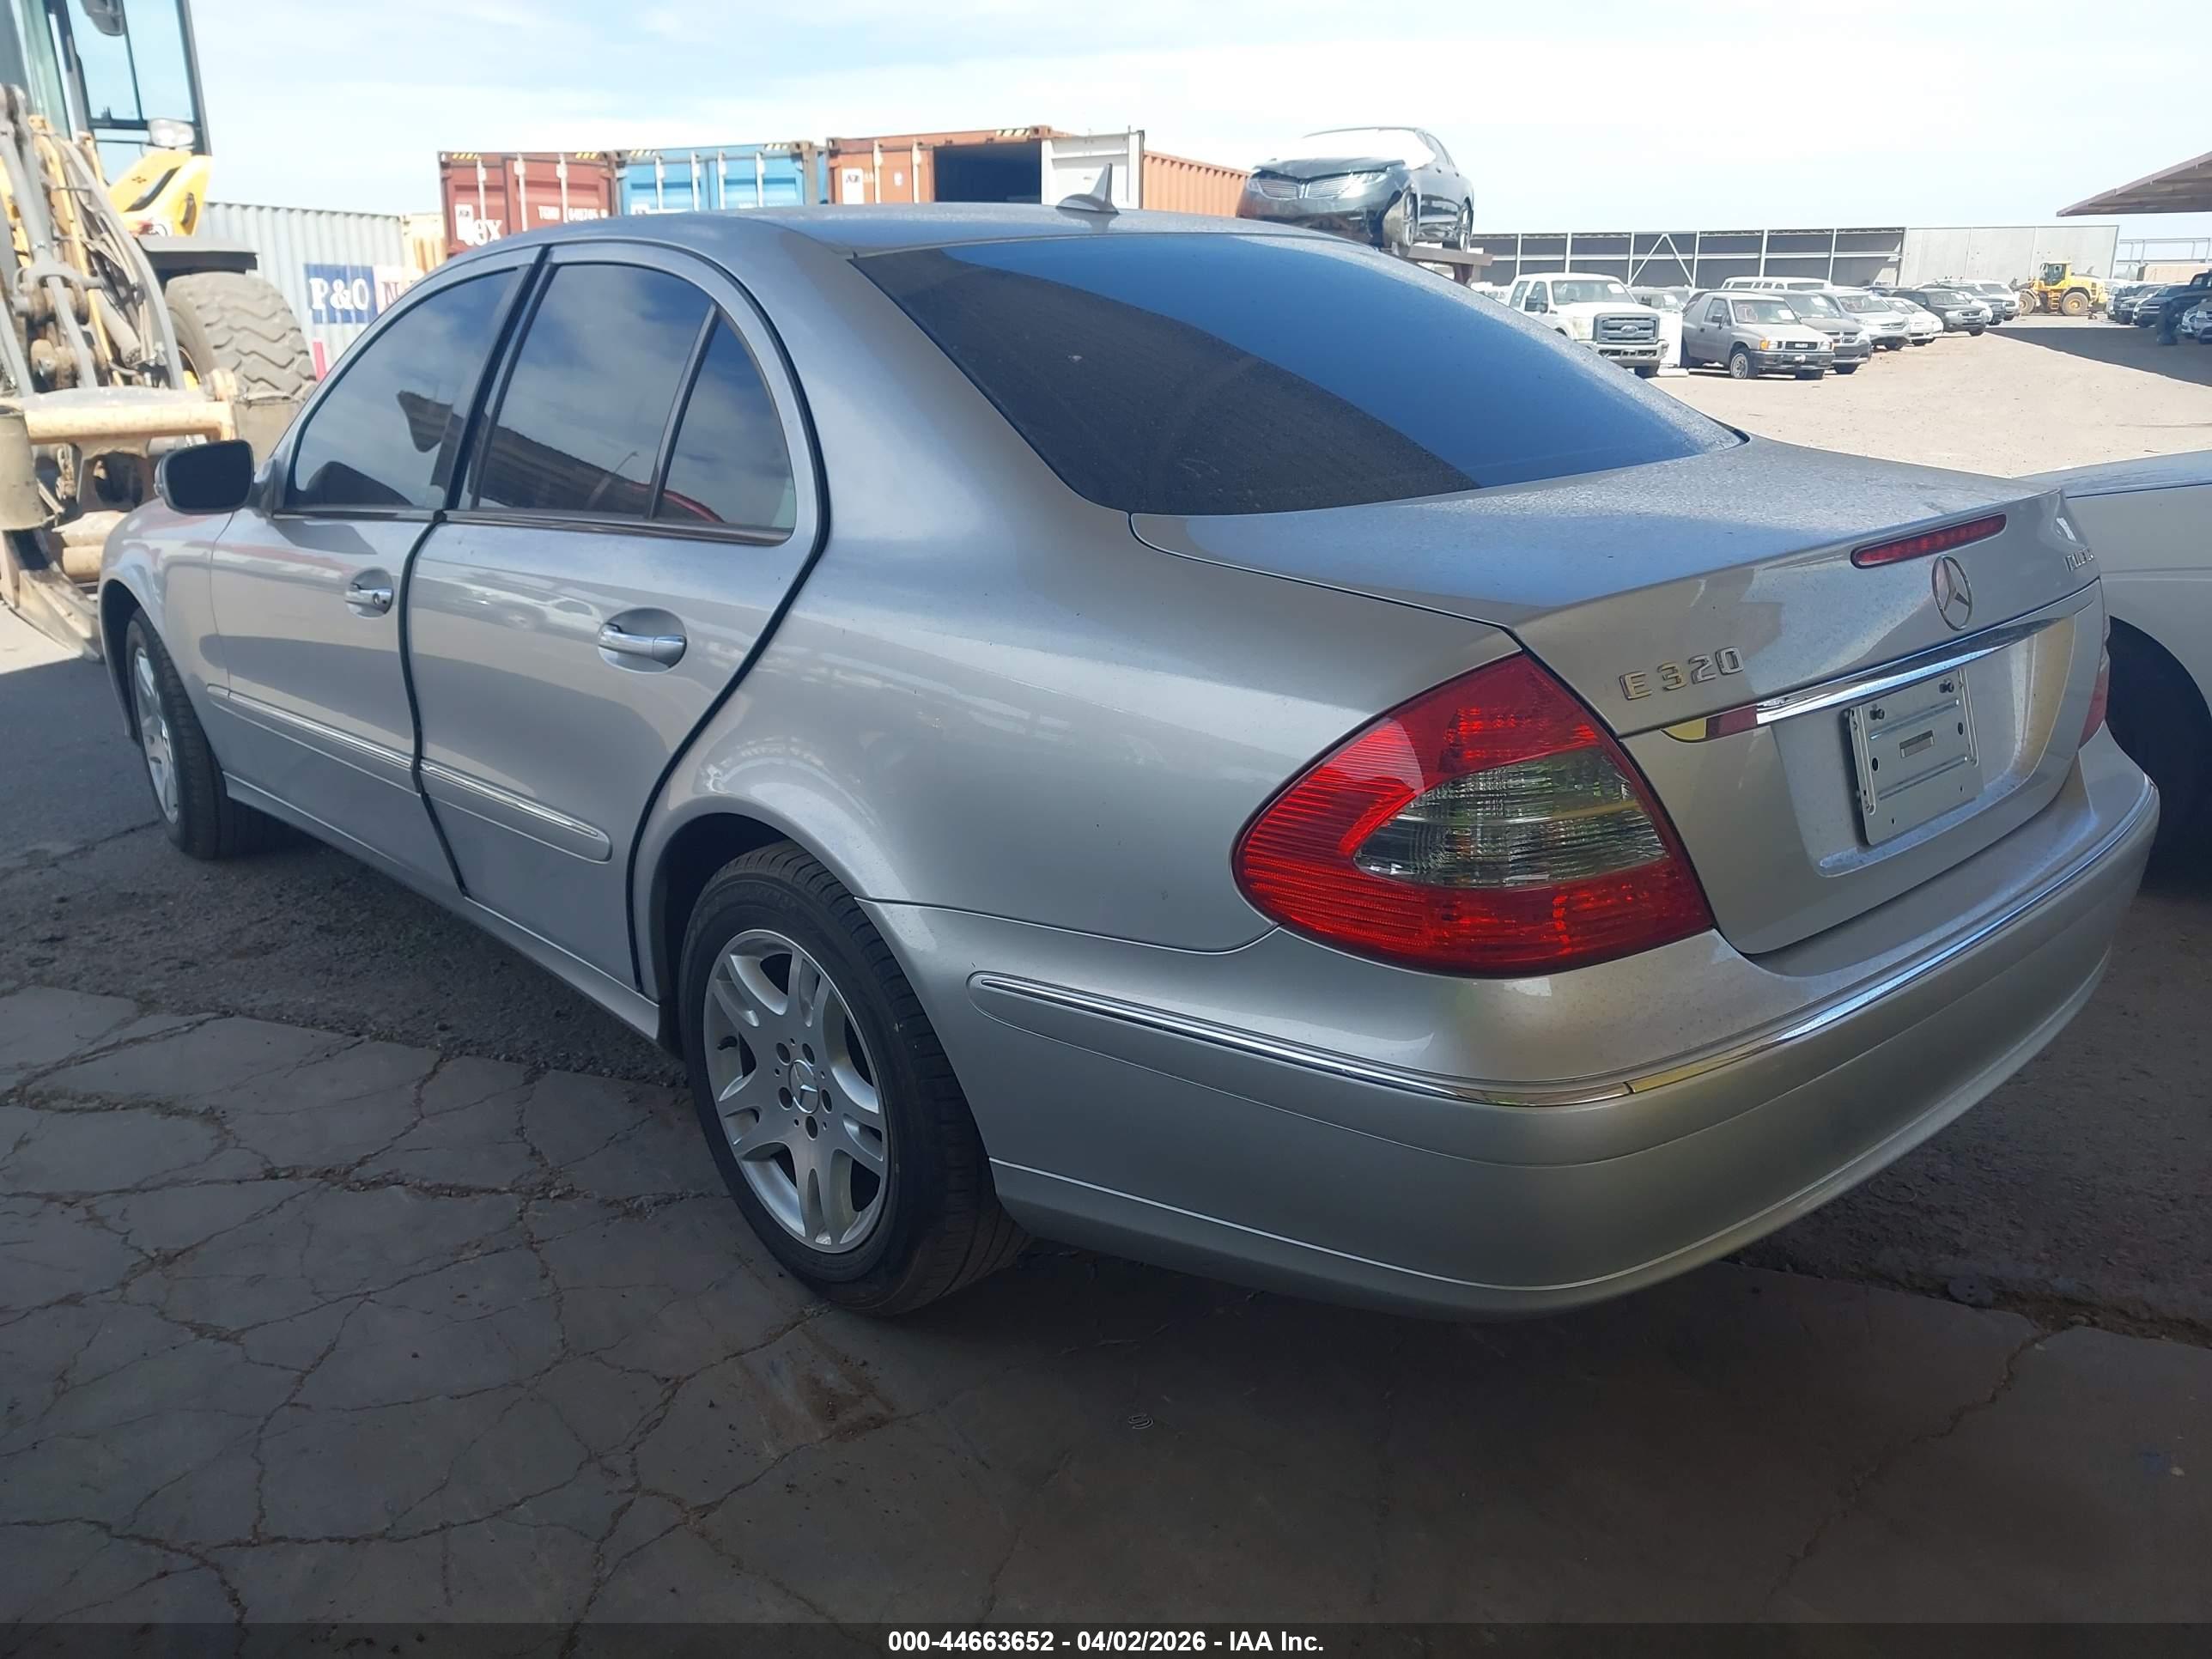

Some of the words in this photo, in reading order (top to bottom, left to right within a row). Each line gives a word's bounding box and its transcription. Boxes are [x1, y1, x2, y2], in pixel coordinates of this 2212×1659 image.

[309, 277, 369, 310] P&O
[1619, 671, 1652, 701] E
[1657, 647, 1744, 690] 320
